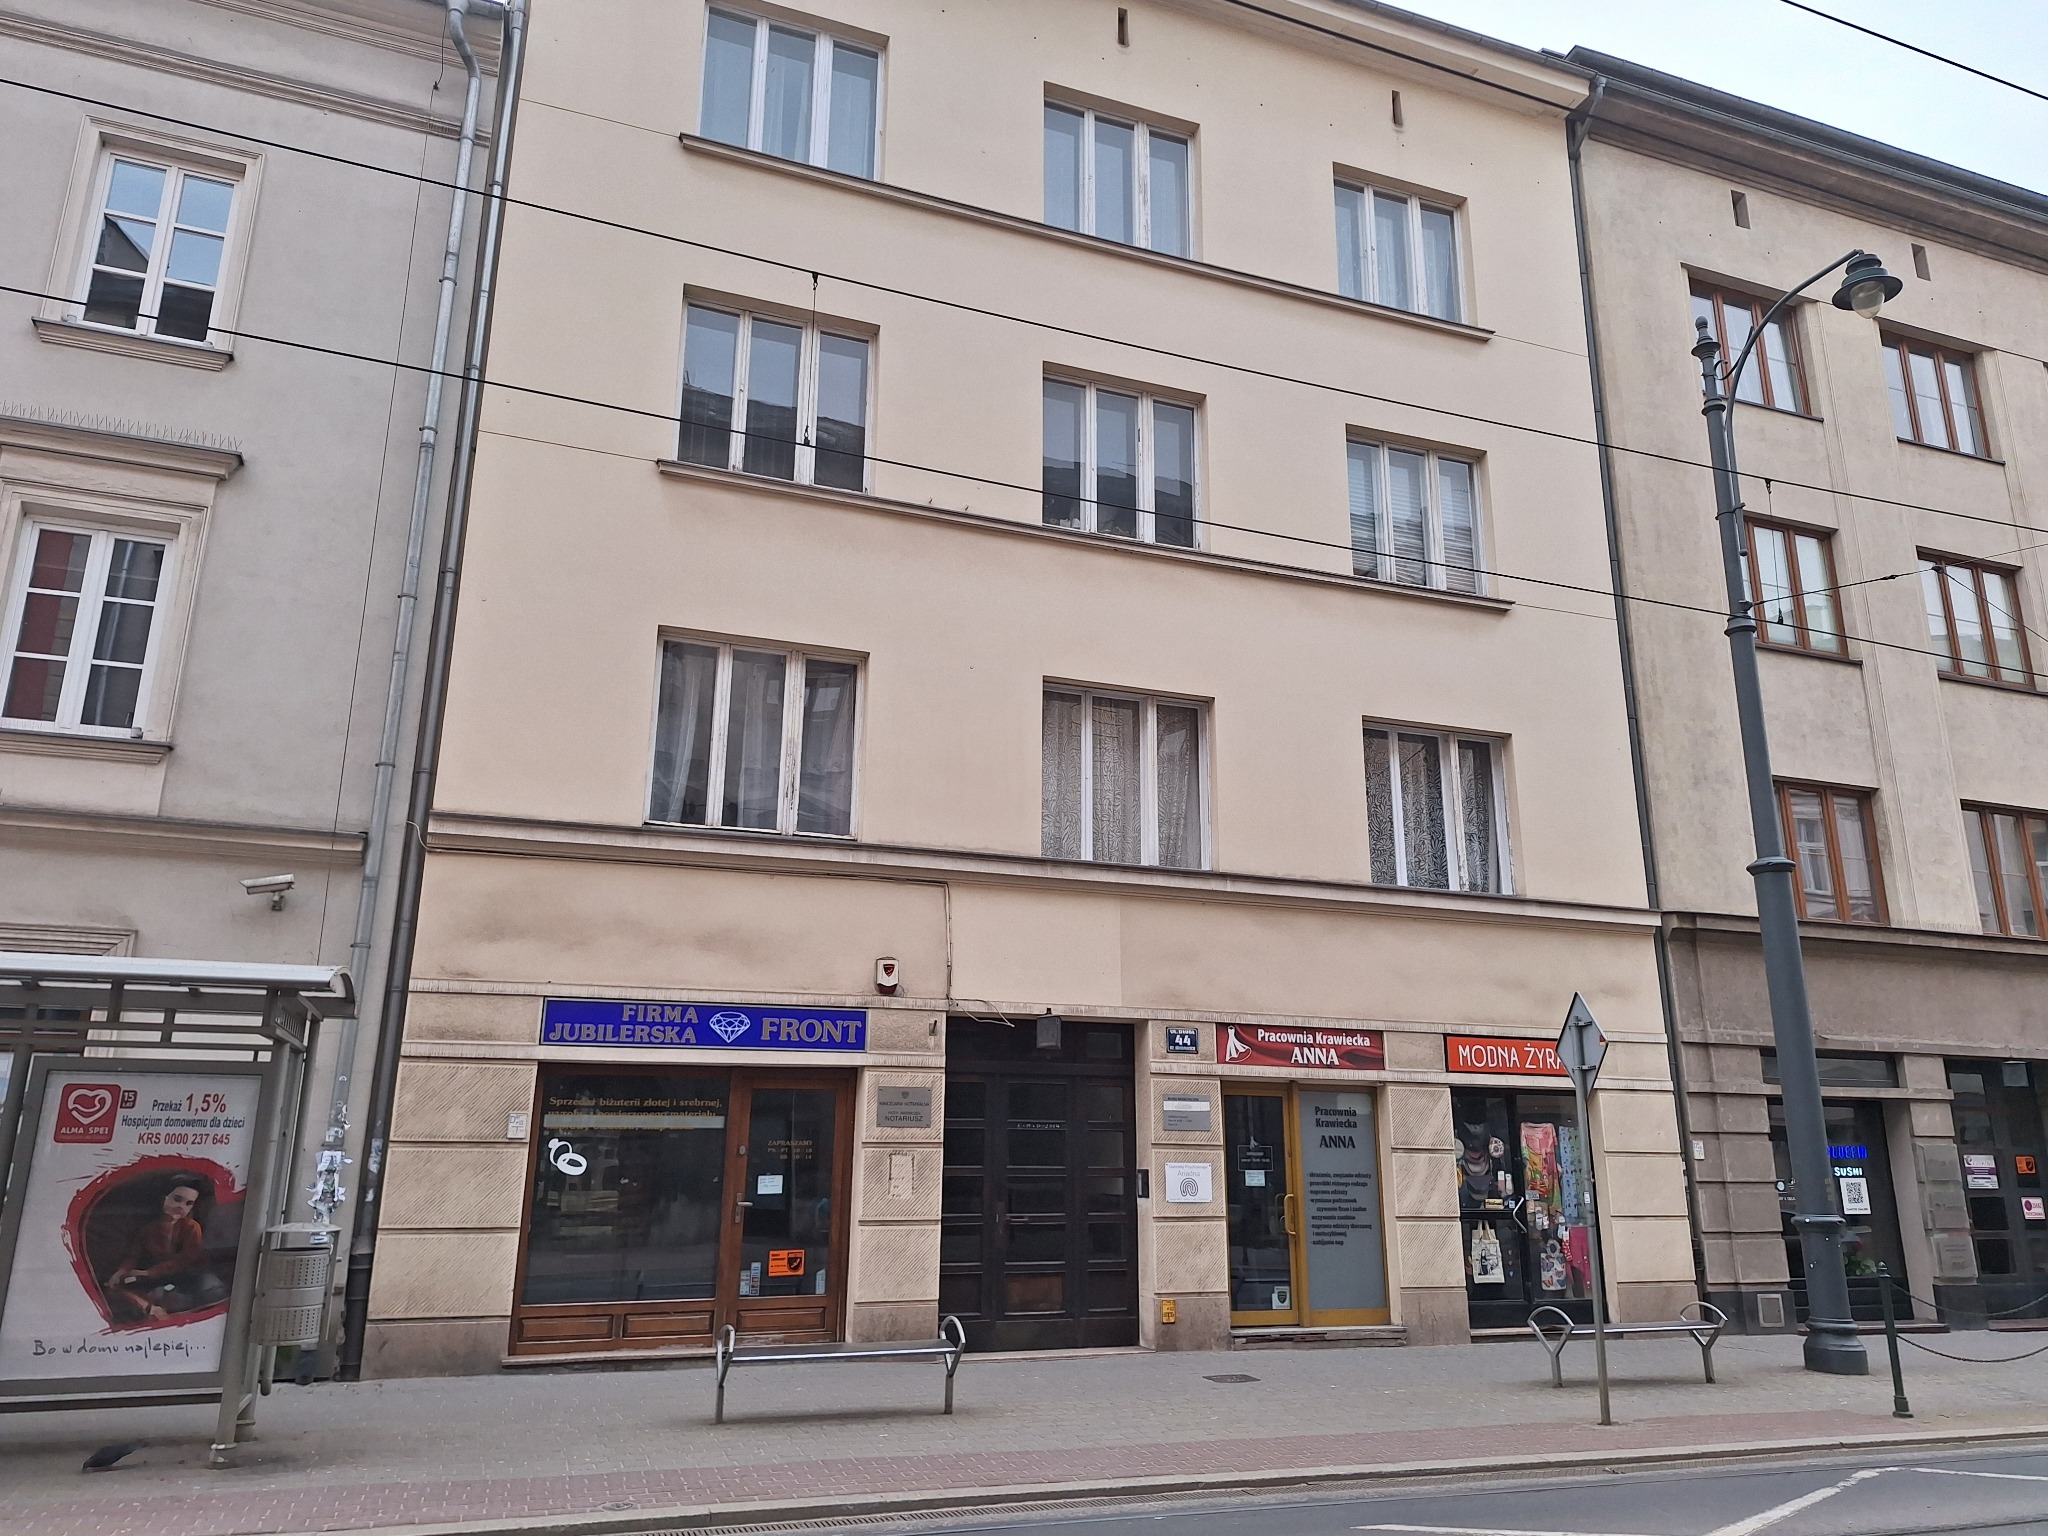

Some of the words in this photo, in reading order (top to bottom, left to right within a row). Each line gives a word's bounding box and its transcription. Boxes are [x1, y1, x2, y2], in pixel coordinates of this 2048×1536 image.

[622, 1004, 698, 1023] FIRMA
[549, 1023, 697, 1043] JUBILERSKA
[761, 1018, 862, 1043] FRONT
[1257, 1028, 1313, 1044] Pracownia
[1315, 1032, 1371, 1047] Krawiecka
[1174, 1035, 1191, 1046] 44
[1290, 1046, 1340, 1066] ANNA
[1458, 1044, 1520, 1068] MODNA
[123, 1092, 135, 1101] 15
[599, 1097, 641, 1107] biżuterii
[643, 1097, 670, 1108] złotej
[679, 1097, 723, 1109] srebrnej,
[152, 1099, 182, 1112] Przekaż
[185, 1093, 227, 1116] 1,5%
[1314, 1106, 1357, 1117] Pracownia
[121, 1115, 162, 1130] Hospicjum
[164, 1115, 208, 1128] domowemu
[209, 1116, 221, 1128] dla
[222, 1116, 246, 1128] dzieci
[1315, 1117, 1358, 1129] Krawiecka
[60, 1126, 84, 1134] ALMA
[88, 1126, 109, 1135] SPEI
[138, 1132, 161, 1145] KRS
[164, 1132, 189, 1145] 0000
[191, 1133, 209, 1145] 237
[212, 1133, 231, 1145] 645
[1319, 1135, 1356, 1149] ANNA
[1833, 1166, 1863, 1177] SUSHI
[32, 1339, 56, 1356] Bo
[62, 1344, 72, 1354] w
[77, 1337, 118, 1354] domu
